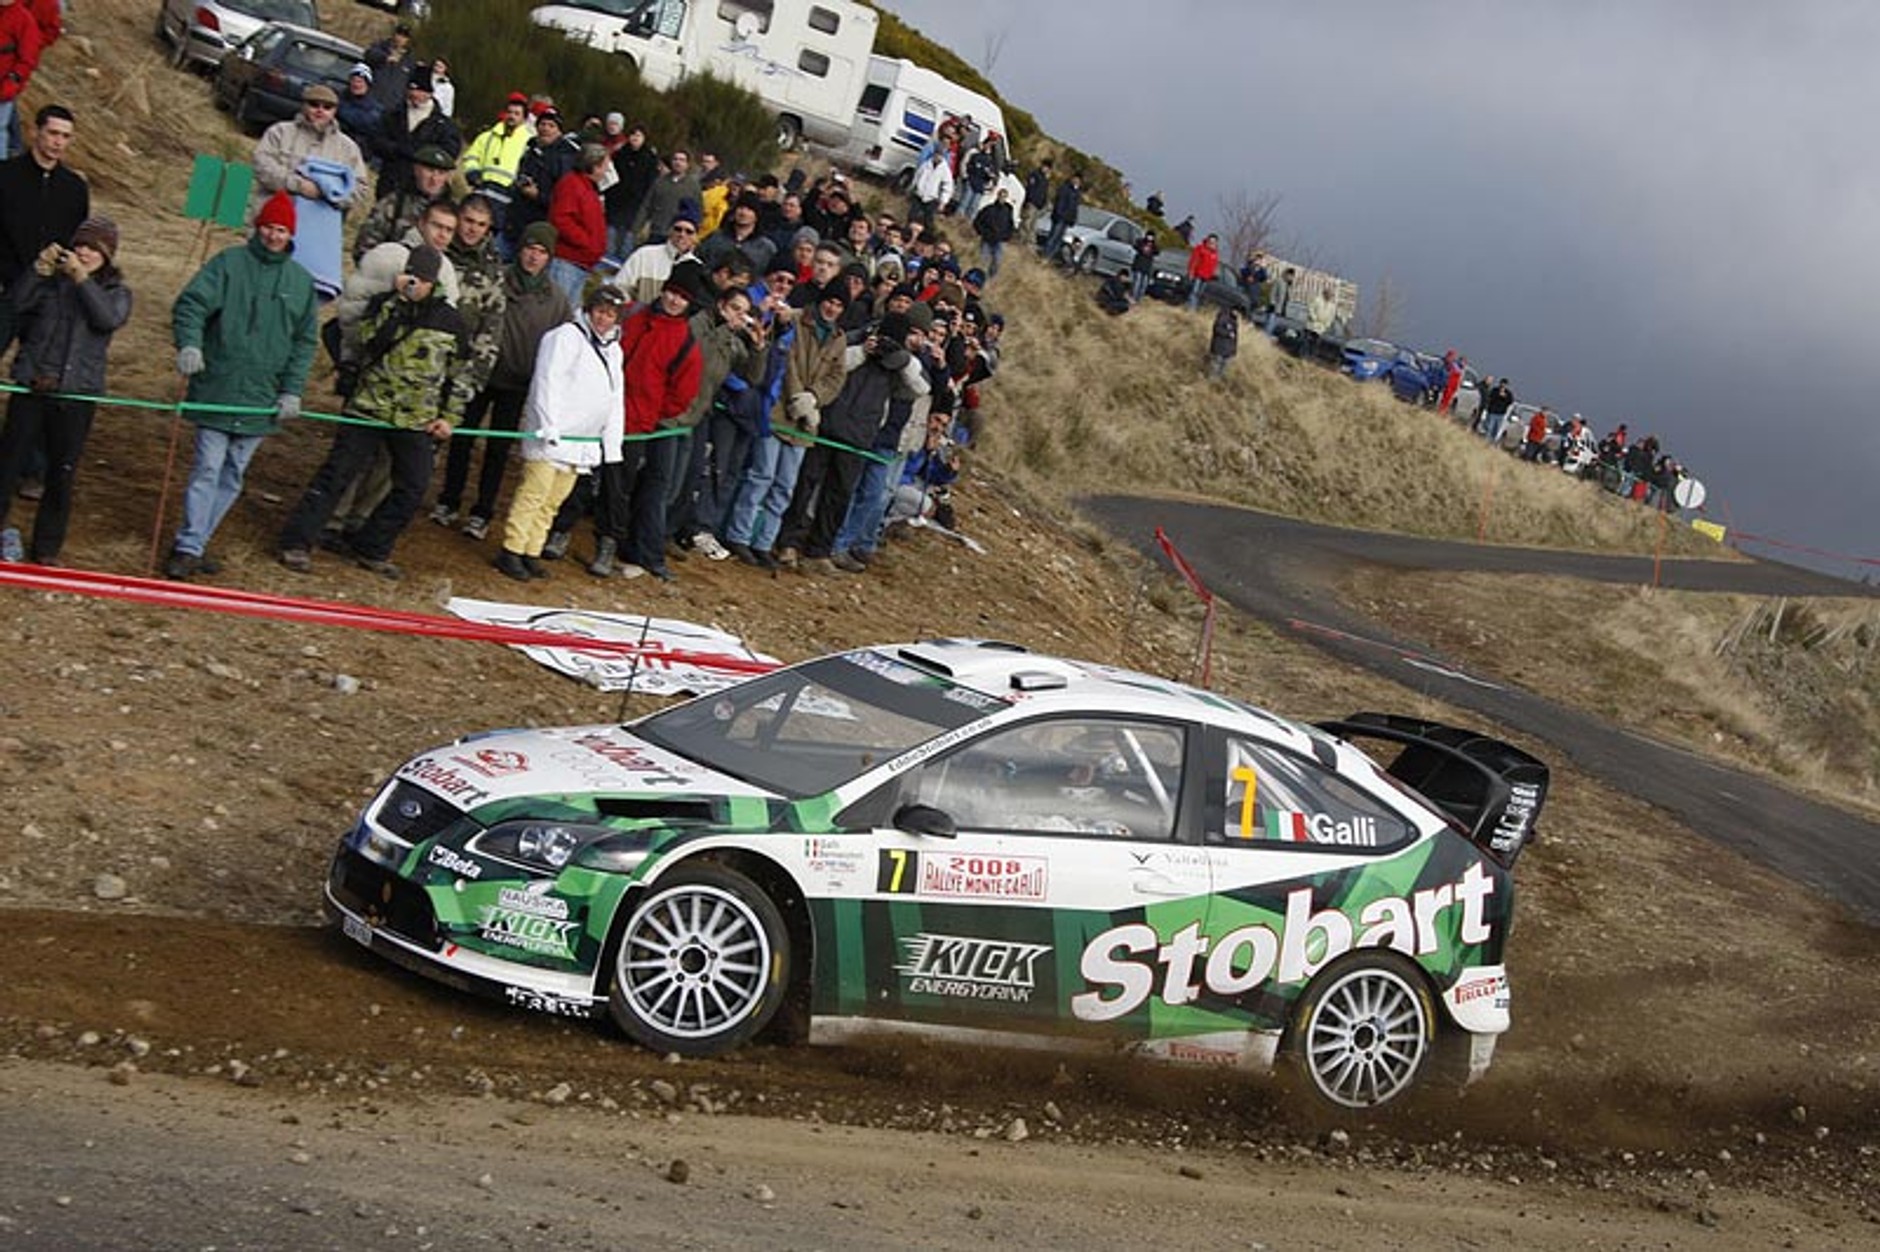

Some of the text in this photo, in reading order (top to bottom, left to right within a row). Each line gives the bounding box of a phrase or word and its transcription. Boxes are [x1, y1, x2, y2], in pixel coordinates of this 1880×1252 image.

[402, 757, 490, 805] Stobart
[1231, 766, 1257, 840] 7
[1311, 813, 1377, 847] Galli
[446, 851, 483, 880] Beta
[889, 850, 907, 894] 7
[924, 861, 1045, 897] RALLYE MONTE CARLO
[950, 857, 1022, 877] 2008
[480, 908, 581, 947] KICK
[1071, 860, 1495, 1023] Stobart
[905, 932, 1054, 987] KICK
[908, 976, 1034, 1004] ENERGYDRINK
